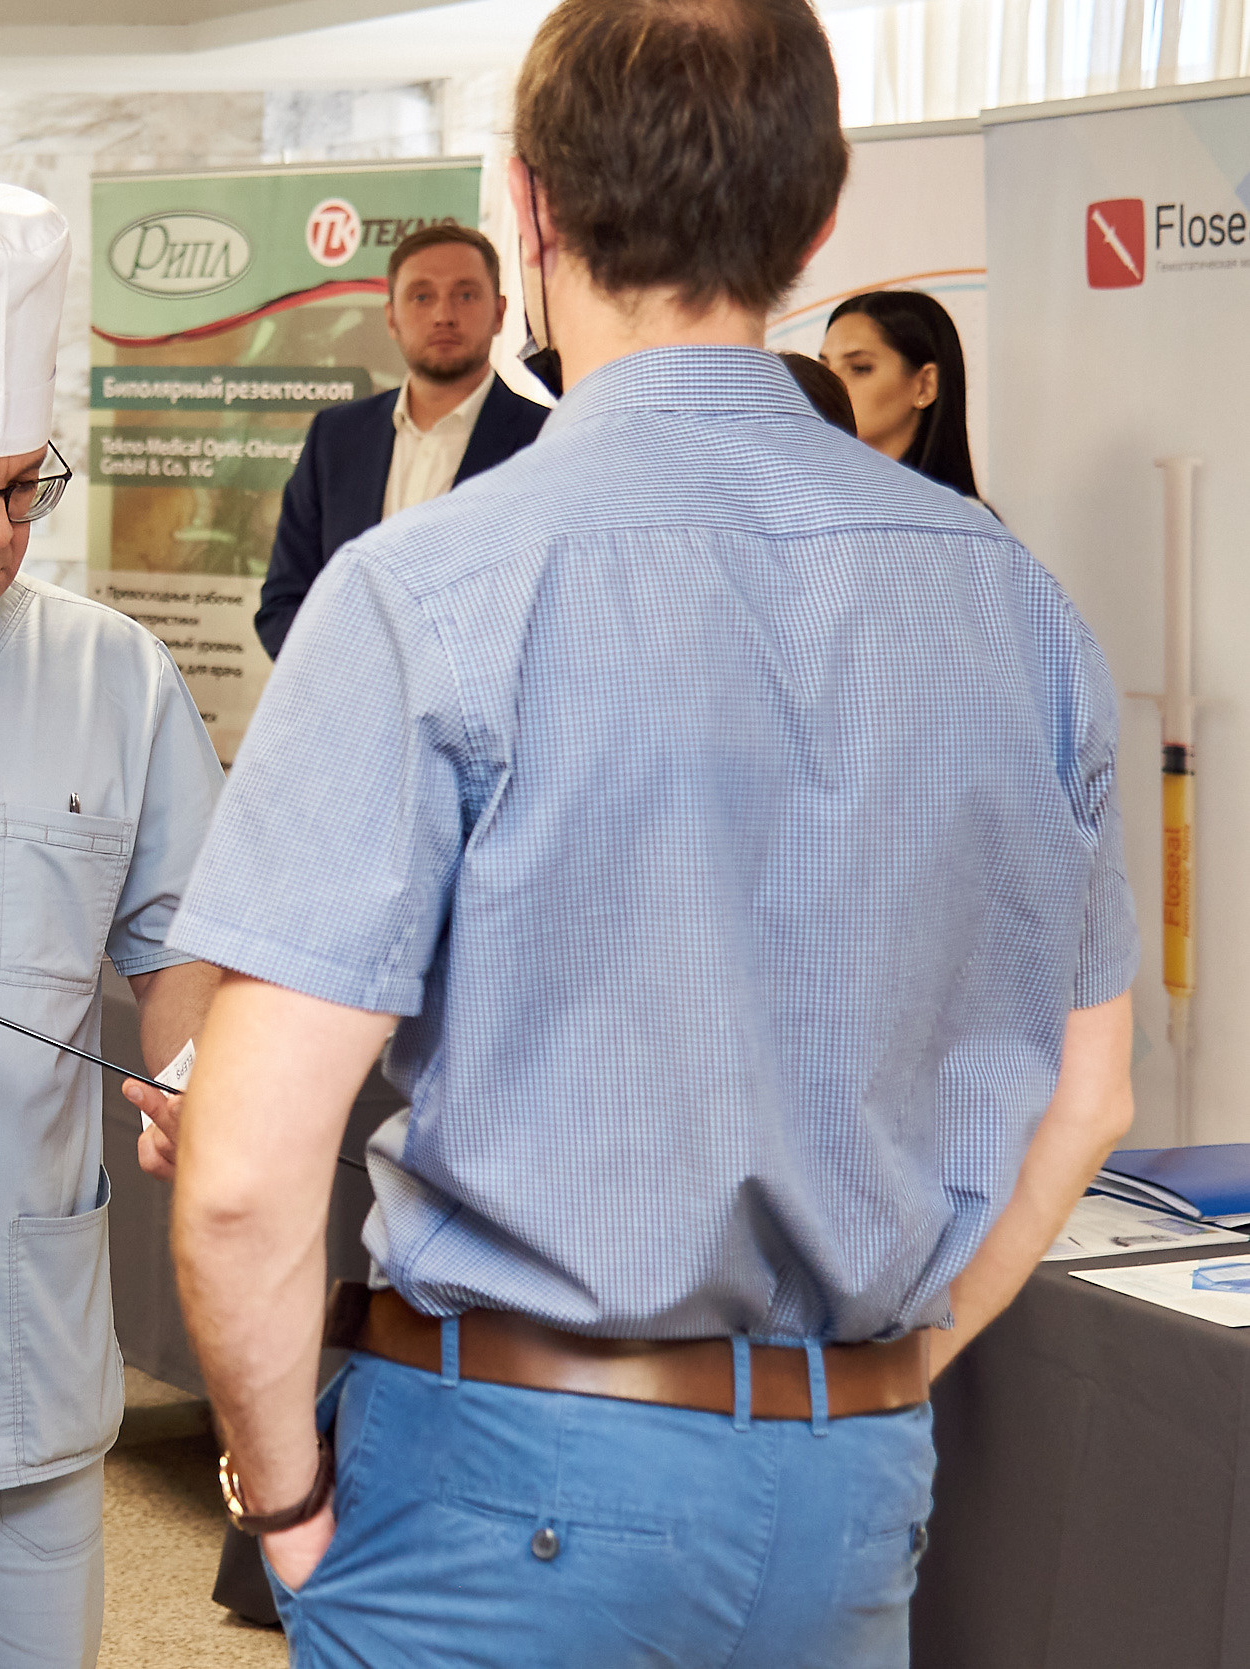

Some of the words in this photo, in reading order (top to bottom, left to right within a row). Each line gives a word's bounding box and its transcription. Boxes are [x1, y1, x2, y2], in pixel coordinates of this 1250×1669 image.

[1155, 203, 1250, 250] Flose
[103, 375, 223, 405] Биполярный
[224, 380, 355, 405] резектоскоп
[189, 459, 214, 478] KG
[1163, 828, 1181, 927] Floseal
